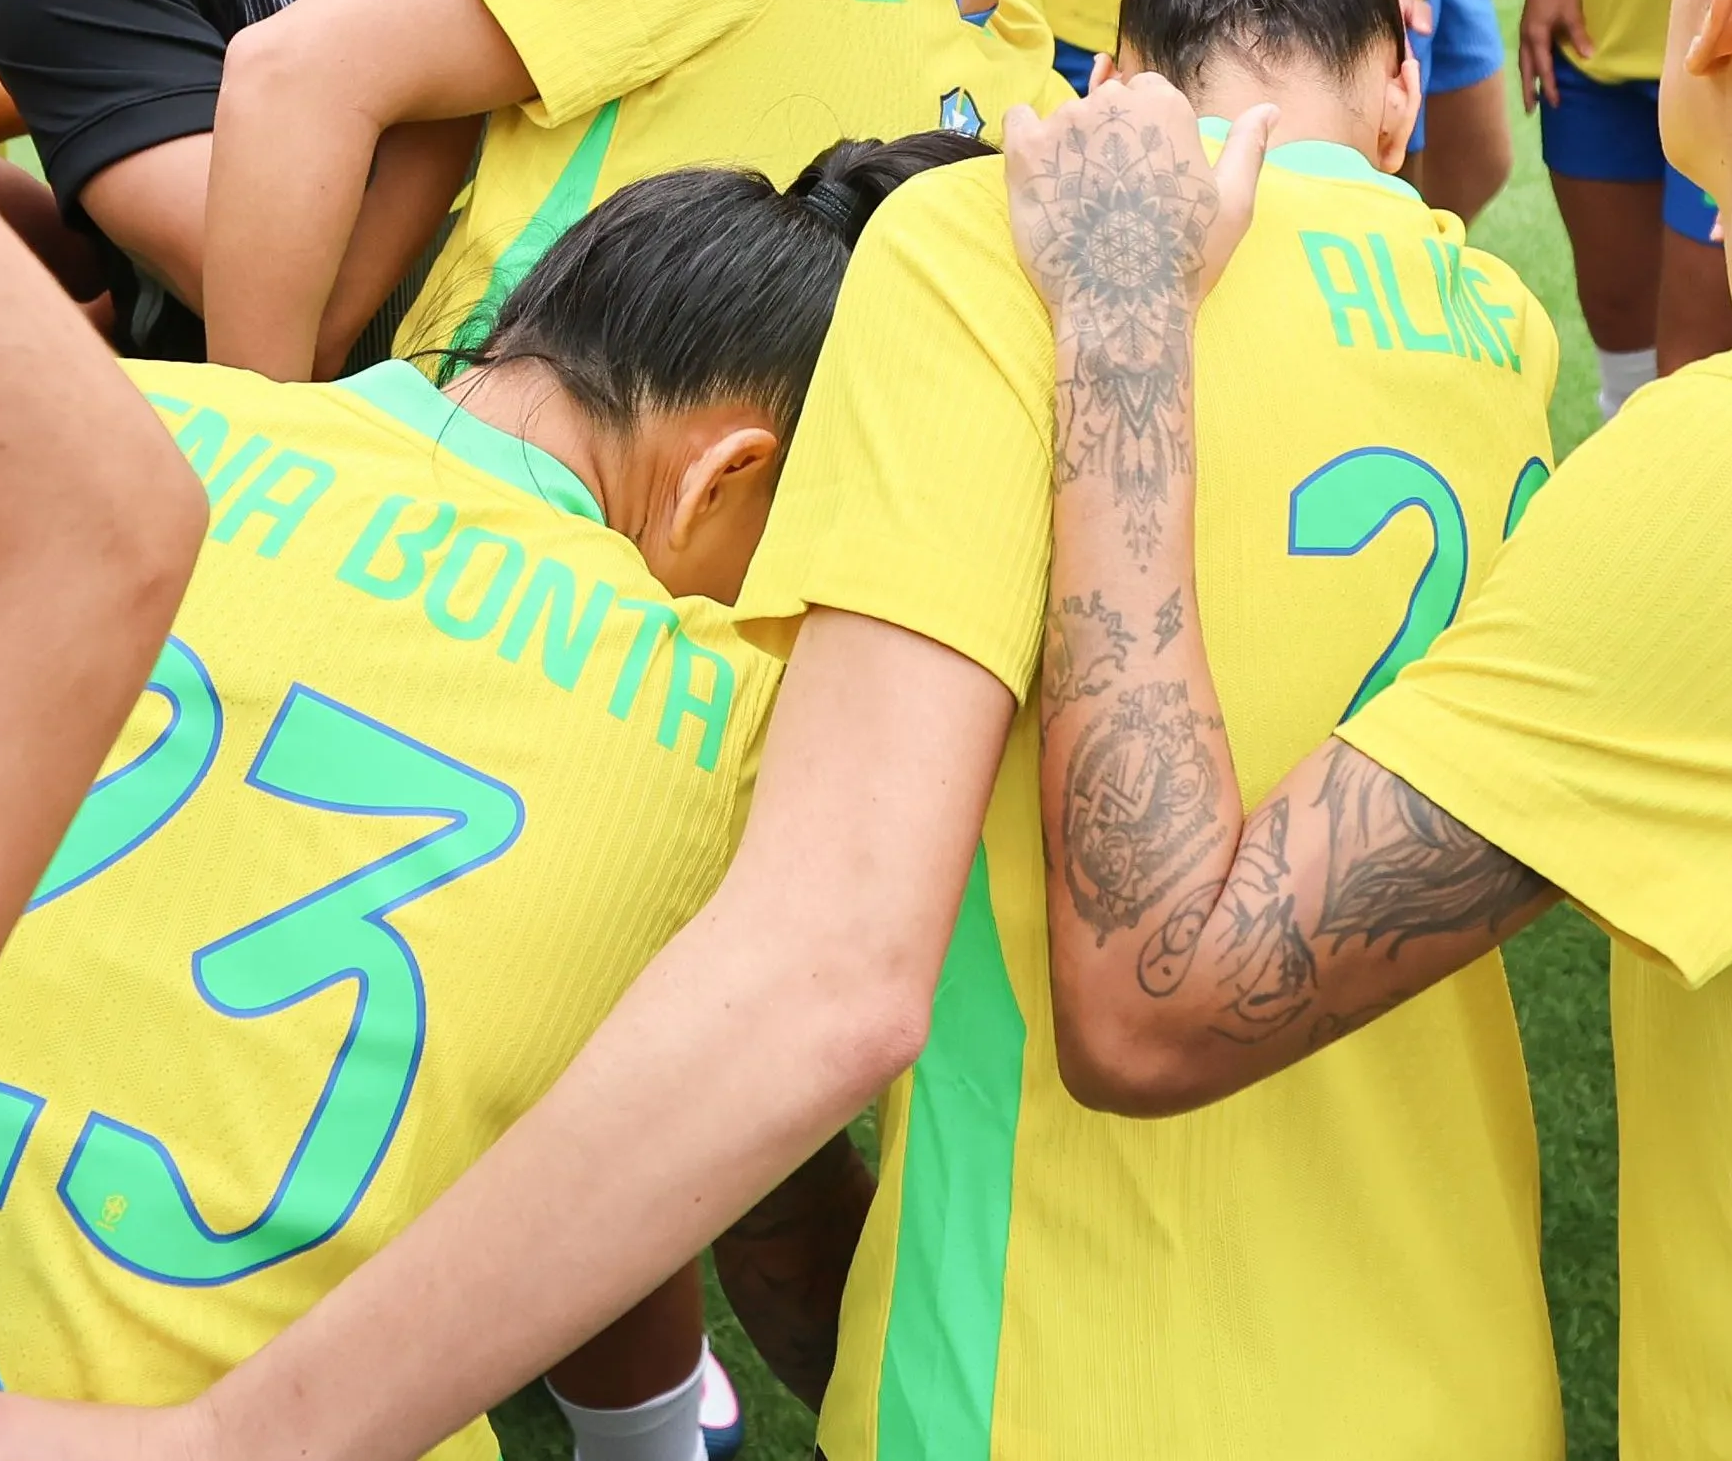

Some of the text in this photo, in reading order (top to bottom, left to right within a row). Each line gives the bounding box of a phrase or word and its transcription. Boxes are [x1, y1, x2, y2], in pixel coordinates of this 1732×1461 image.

[1298, 230, 1523, 375] ALINE
[334, 494, 736, 773] BONTA
[1288, 446, 1552, 726] 2
